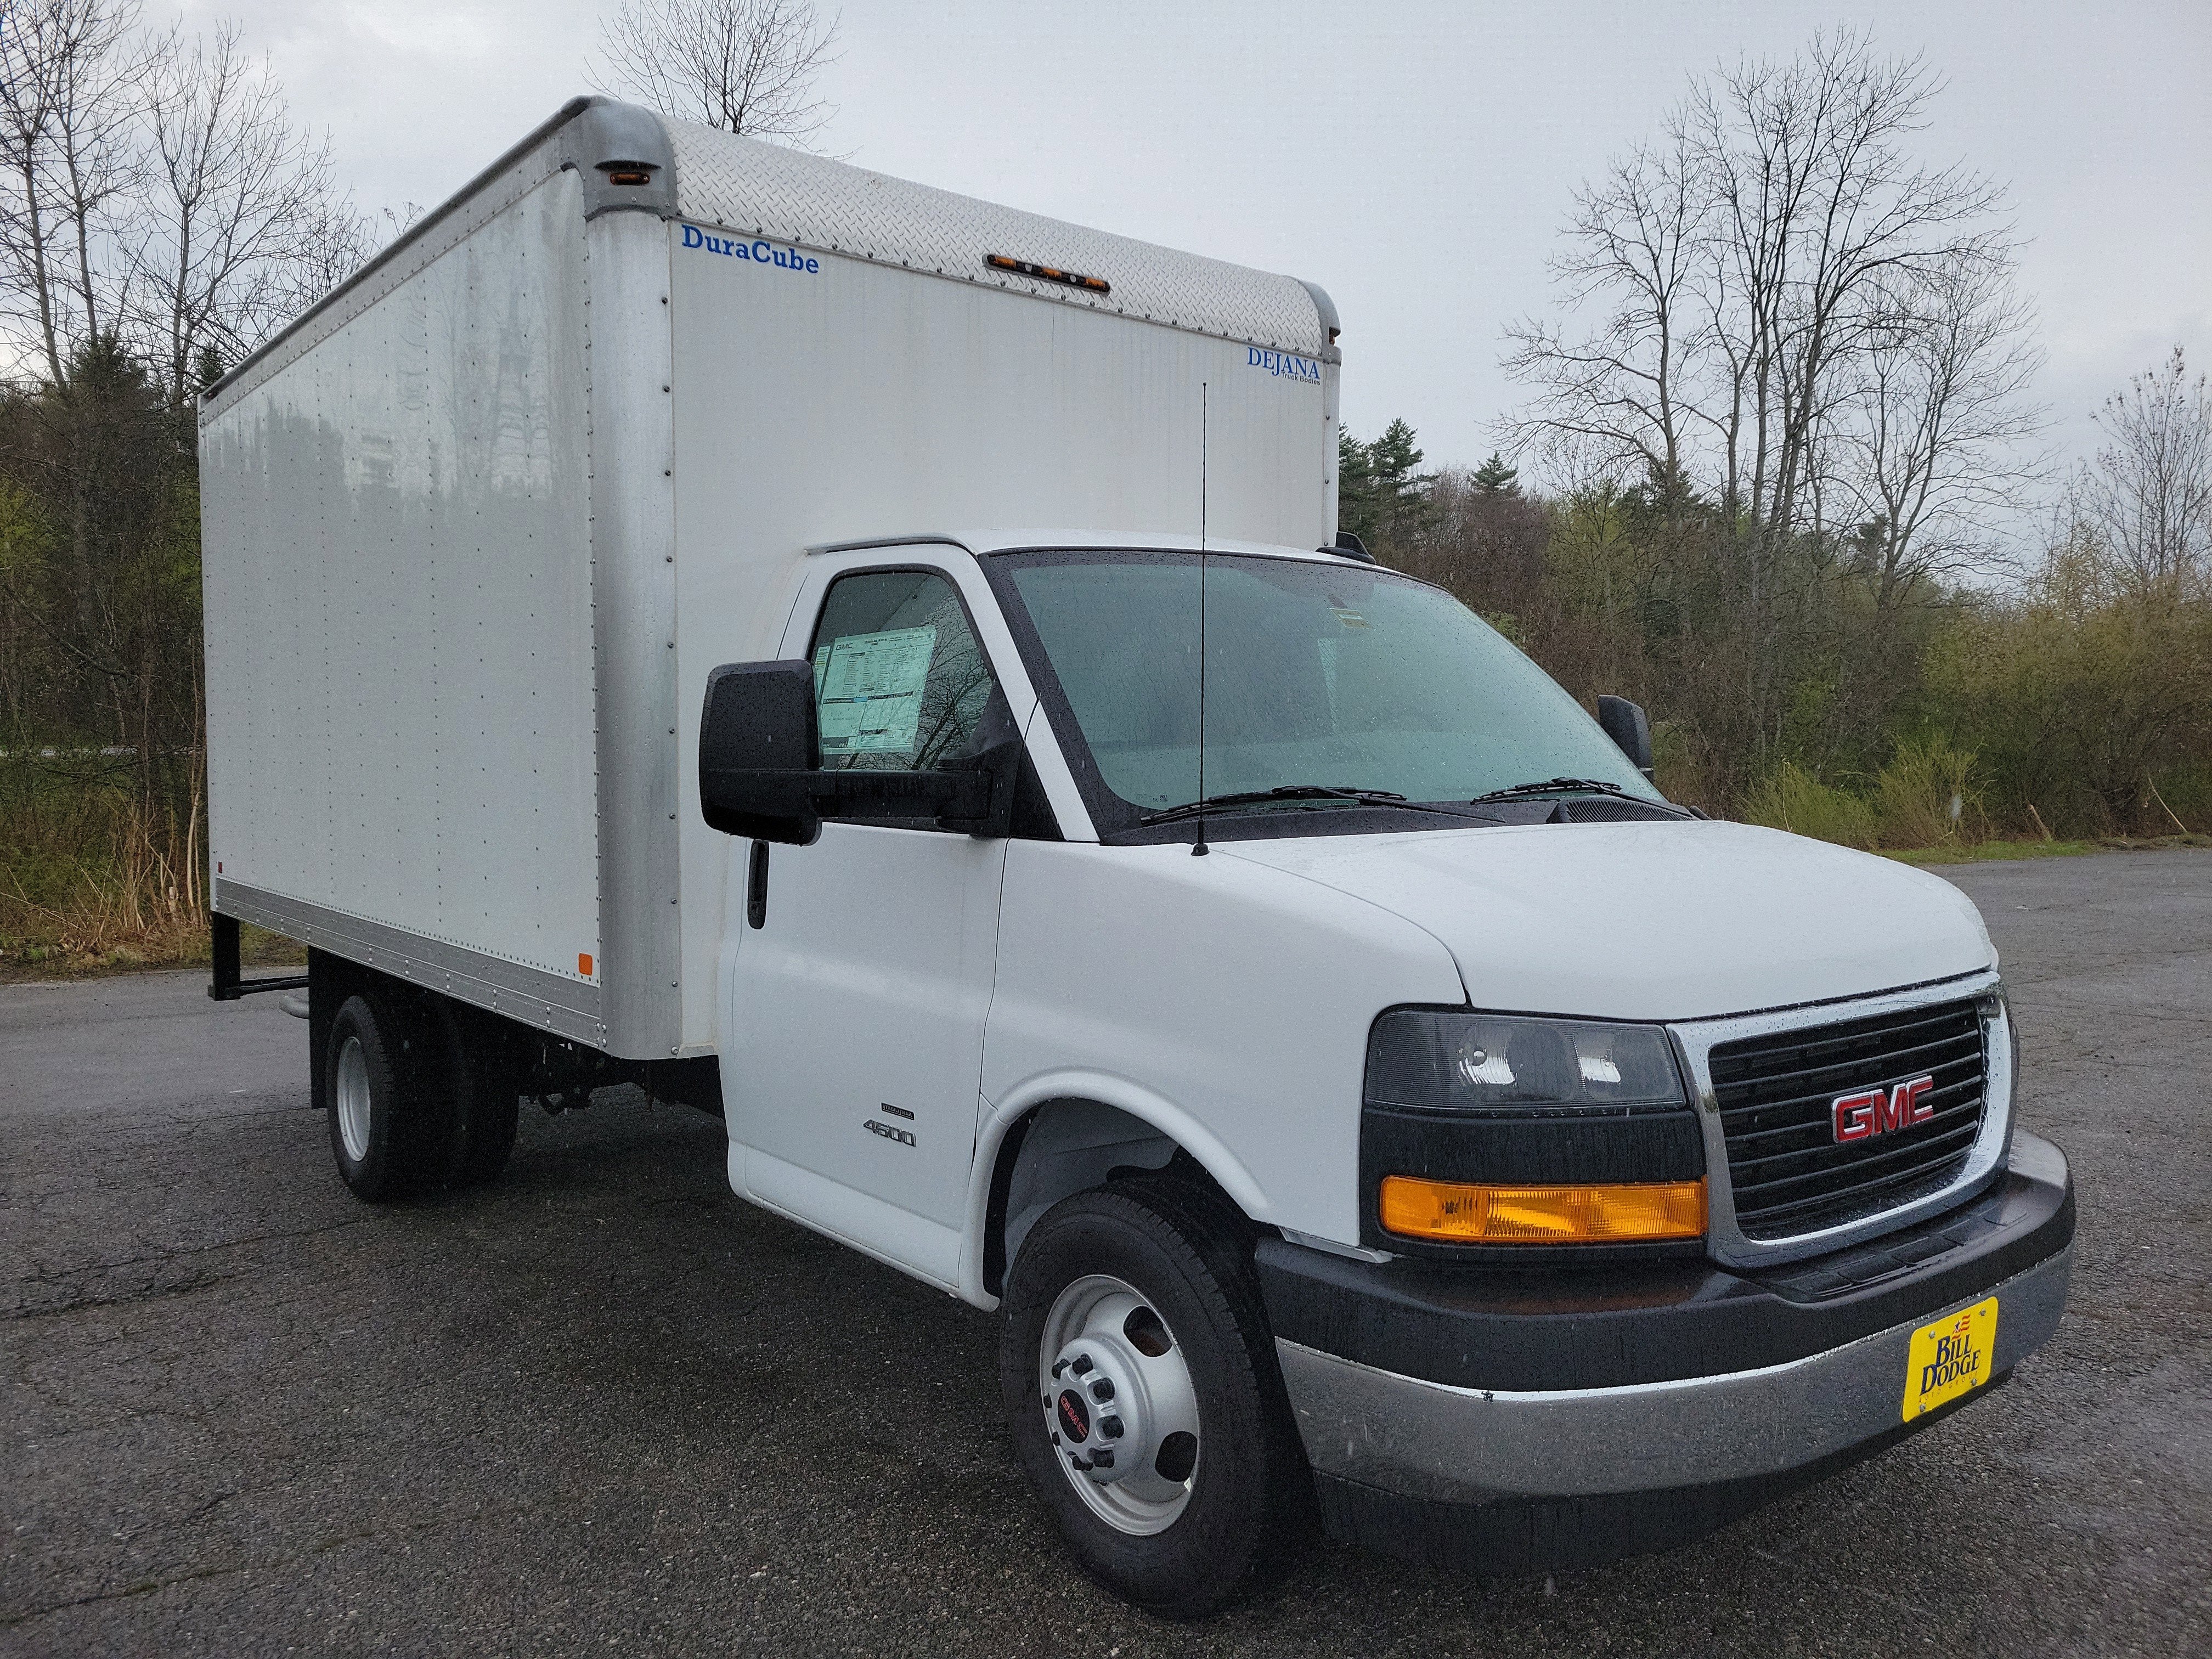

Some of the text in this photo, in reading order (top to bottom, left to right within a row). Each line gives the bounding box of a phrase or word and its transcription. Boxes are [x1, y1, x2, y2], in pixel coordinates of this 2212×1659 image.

[681, 224, 819, 274] DuraCube
[1248, 347, 1320, 380] DEJANA
[1282, 371, 1298, 381] Truck
[836, 642, 854, 651] GMC
[1831, 1075, 1934, 1143] GMC
[863, 1119, 916, 1147] 4500
[1935, 1334, 1973, 1367] BILL
[1919, 1350, 1981, 1397] DODGE
[1060, 1395, 1087, 1437] GMC
